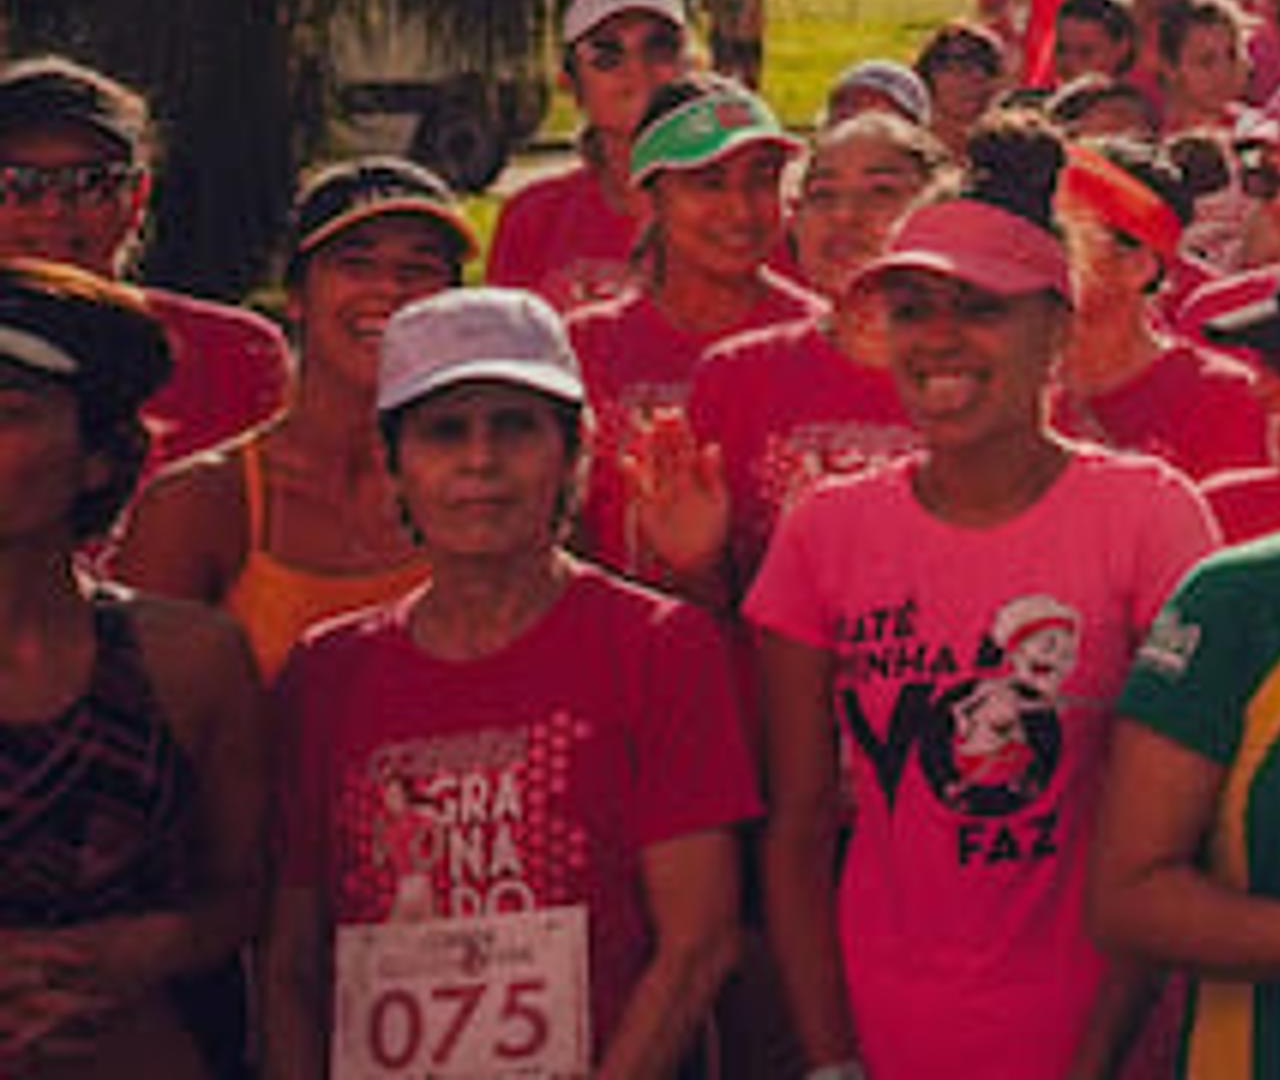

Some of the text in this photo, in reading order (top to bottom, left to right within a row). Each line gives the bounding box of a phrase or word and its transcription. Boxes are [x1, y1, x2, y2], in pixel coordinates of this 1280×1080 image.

[449, 823, 522, 880] NA
[957, 813, 1059, 866] FAZ
[369, 982, 550, 1070] 075
